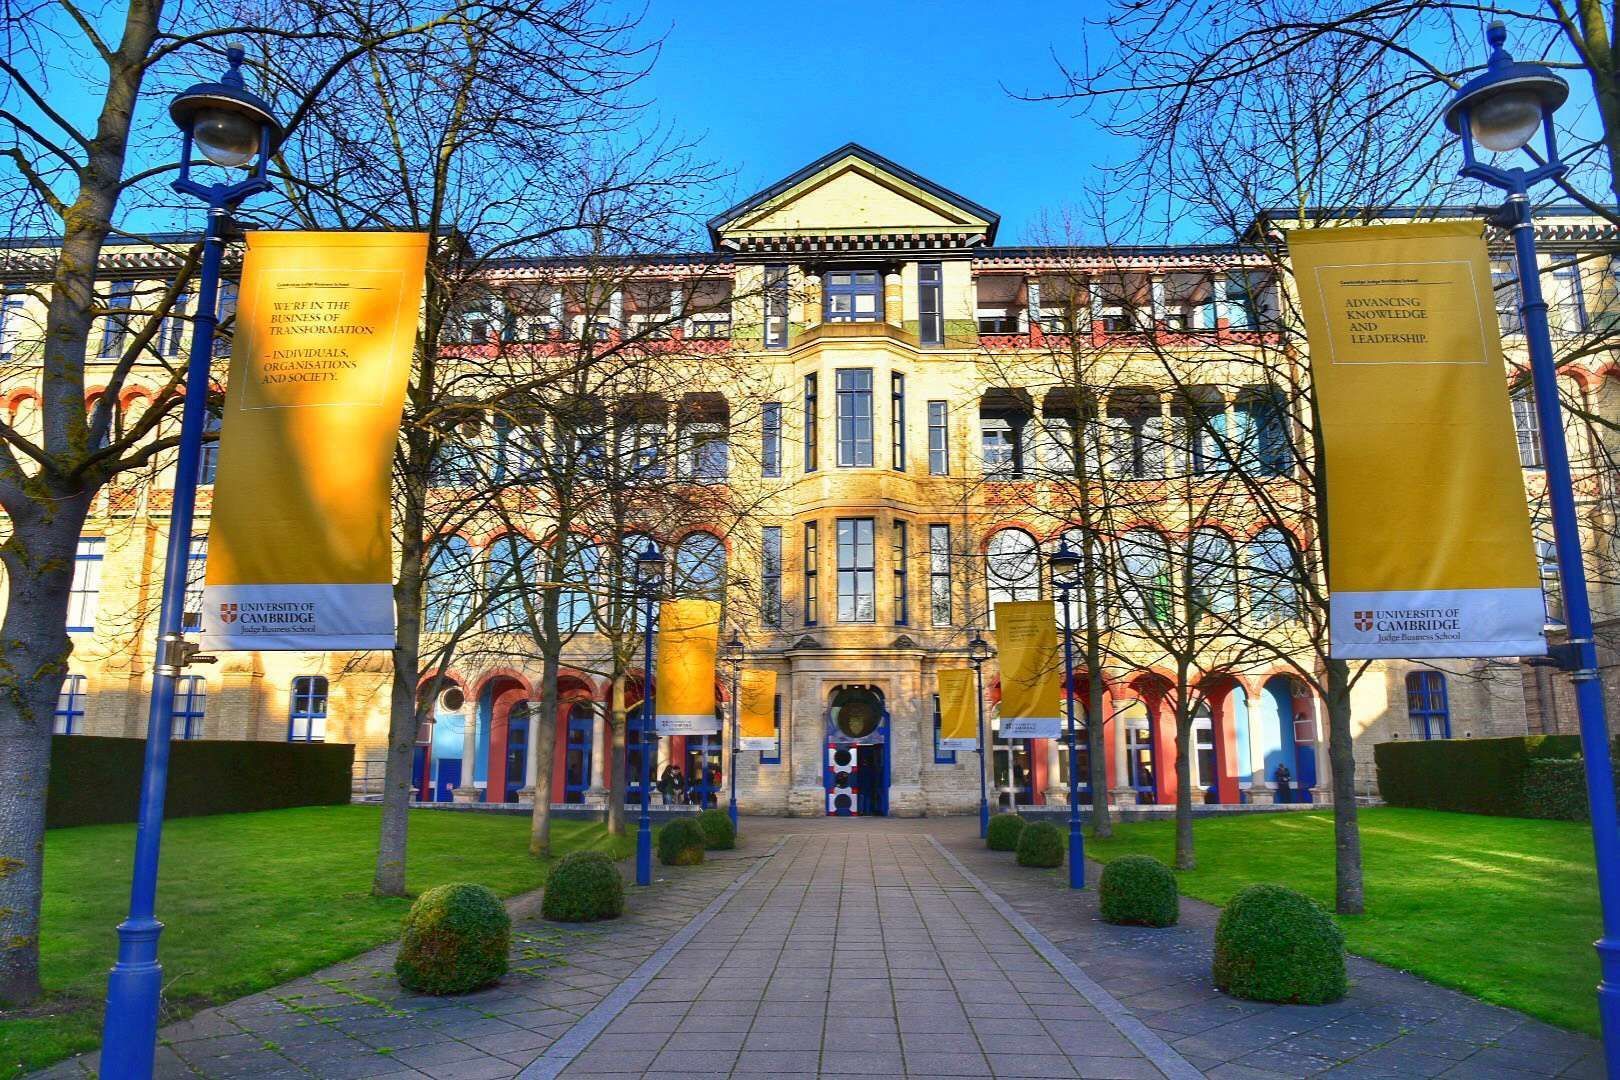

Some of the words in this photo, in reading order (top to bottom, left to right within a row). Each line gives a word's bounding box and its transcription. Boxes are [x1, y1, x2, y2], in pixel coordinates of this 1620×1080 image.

[310, 301, 325, 310] IN
[326, 301, 351, 310] THE
[1345, 298, 1420, 307] ADVANCING
[271, 313, 320, 323] BUSINESS
[323, 313, 340, 322] OF
[1346, 309, 1428, 320] KNOWLEDGE
[269, 325, 376, 336] TRANSFORMATION
[1350, 322, 1378, 332] AND
[1351, 333, 1428, 344] LEADERSHIP.
[273, 348, 349, 359] INDIVIDUALS,
[263, 360, 357, 371] ORGANISATIONS
[261, 374, 287, 384] AND
[288, 372, 338, 383] SOCIETY.
[240, 602, 299, 612] UNIVERSITY
[300, 602, 316, 611] OF
[240, 612, 316, 624] CAMBRIDGE
[1376, 609, 1443, 619] UNIVERSITY
[1445, 608, 1460, 618] OF
[292, 625, 316, 633] School
[1377, 619, 1461, 631] CAMBRIDGE
[1378, 633, 1400, 642] Judge
[1401, 633, 1433, 641] Business
[1434, 632, 1461, 640] School
